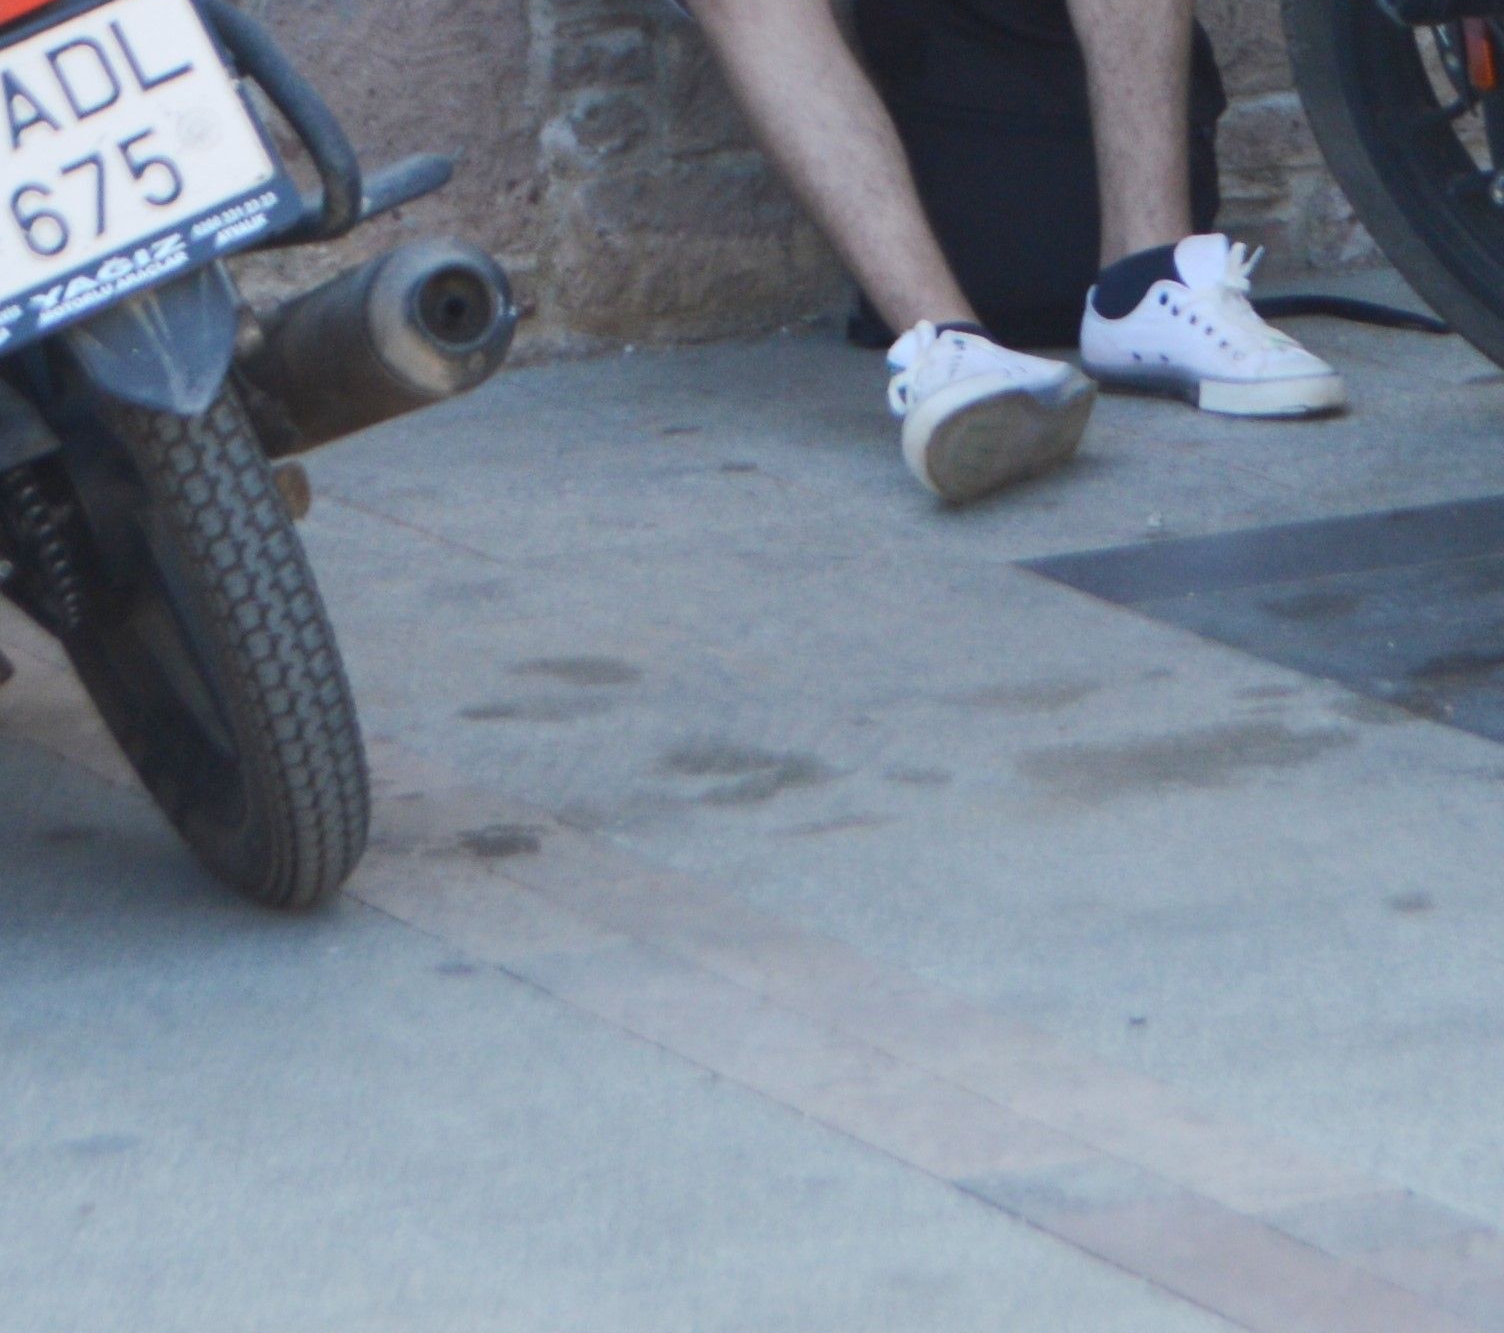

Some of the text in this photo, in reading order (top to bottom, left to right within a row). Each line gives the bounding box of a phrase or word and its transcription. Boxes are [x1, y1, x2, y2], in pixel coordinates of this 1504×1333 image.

[0, 19, 195, 151] ADL
[10, 127, 185, 259] 675
[28, 232, 188, 309] YAĞIZ
